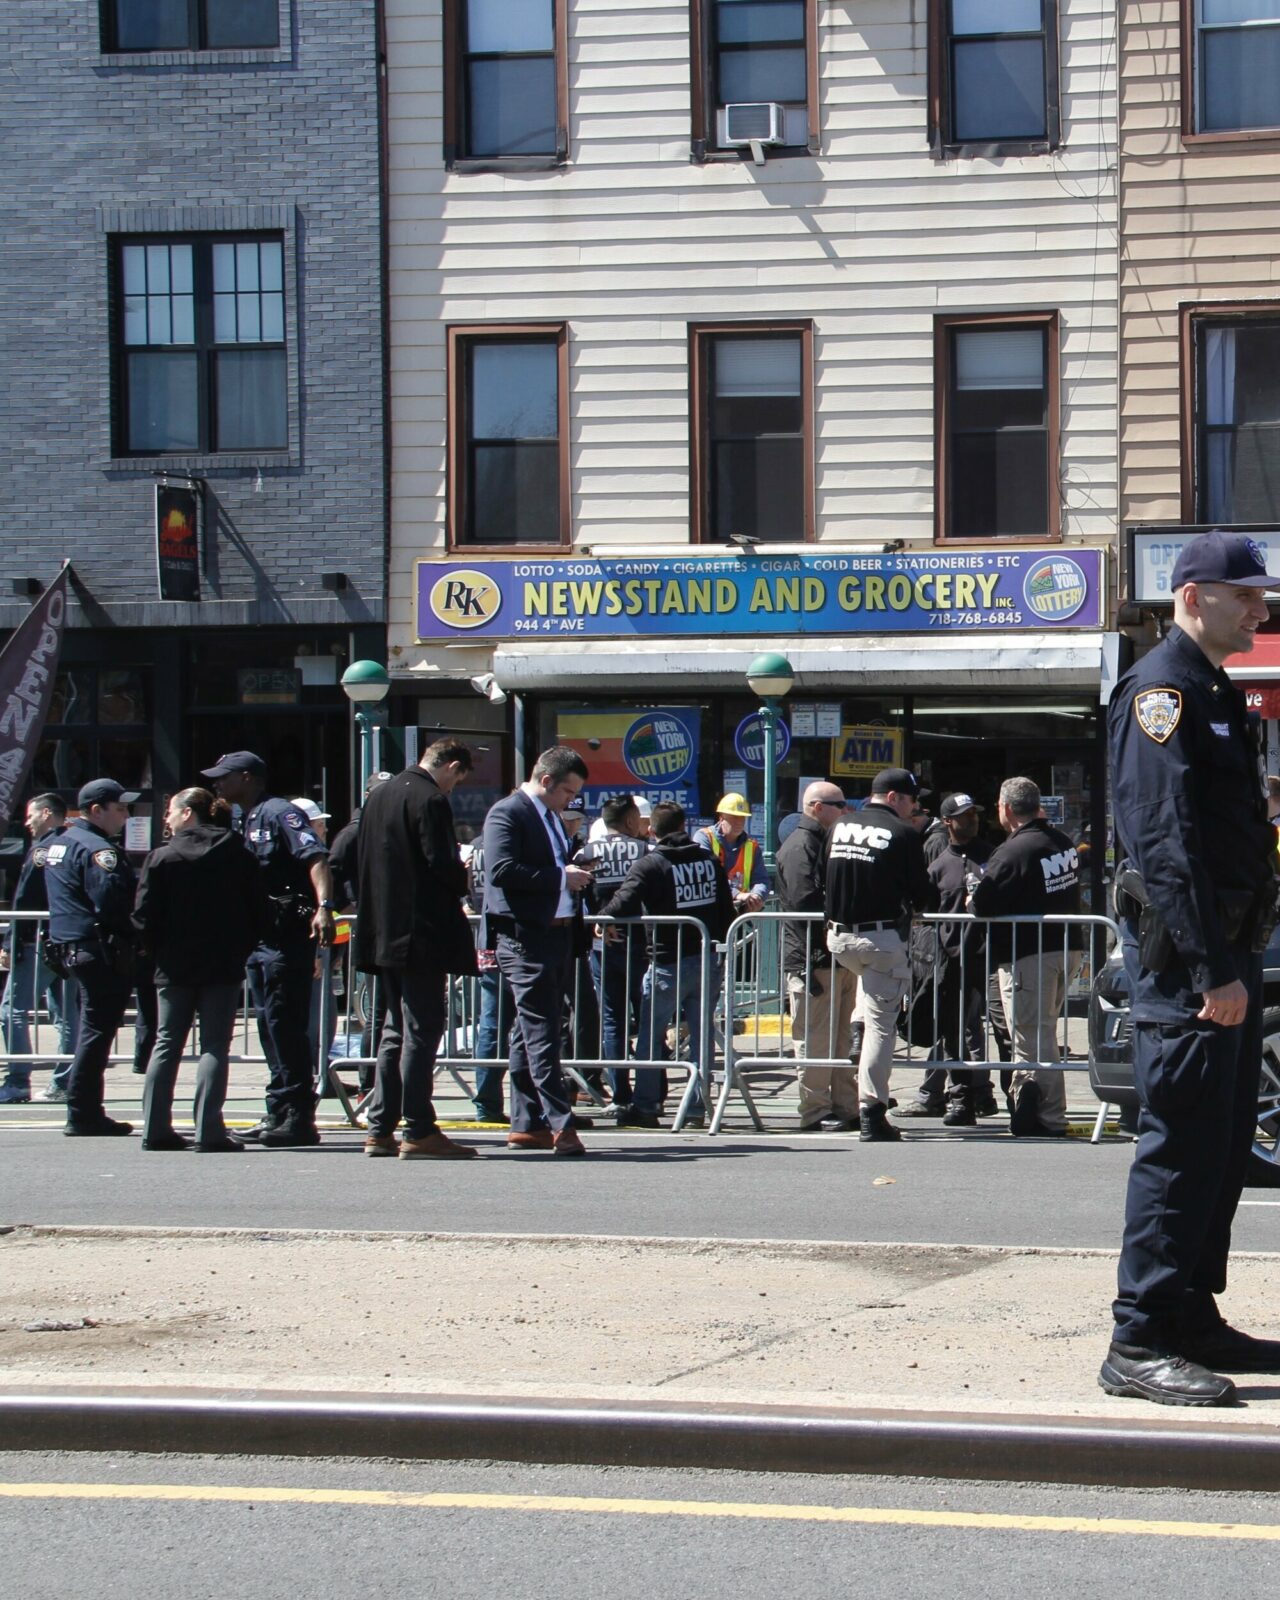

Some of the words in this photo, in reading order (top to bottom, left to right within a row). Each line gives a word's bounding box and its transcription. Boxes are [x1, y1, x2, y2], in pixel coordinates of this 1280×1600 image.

[514, 565, 555, 577] LOTTO
[567, 564, 603, 576] SODA
[615, 563, 660, 575] CANDY
[672, 561, 748, 574] CIGARETTES
[760, 561, 801, 572] CIGAR
[813, 560, 849, 571] COLD
[852, 559, 882, 570] BEER
[896, 557, 985, 570] STATIONERIES
[997, 556, 1020, 568] ETC
[1052, 563, 1074, 575] NEW
[1054, 573, 1081, 589] YORK
[524, 579, 738, 616] NEWSSTAND
[750, 577, 826, 613] AND
[837, 573, 999, 612] GROCERY
[995, 597, 1015, 608] INC.
[1031, 586, 1083, 612] LOTTERY
[514, 619, 539, 631] 944
[560, 619, 585, 631] AVE
[929, 612, 1022, 625] 718-768-6845
[654, 720, 678, 733] NEW
[657, 732, 687, 750] YORK
[841, 737, 895, 763] ATM
[631, 748, 689, 777] LOTTERY
[832, 822, 893, 850] NYC
[593, 841, 639, 861] NYPD
[672, 860, 716, 886] NYPD
[1040, 847, 1079, 879] NYC
[1045, 872, 1075, 886] Emergency
[676, 880, 717, 901] POLICE
